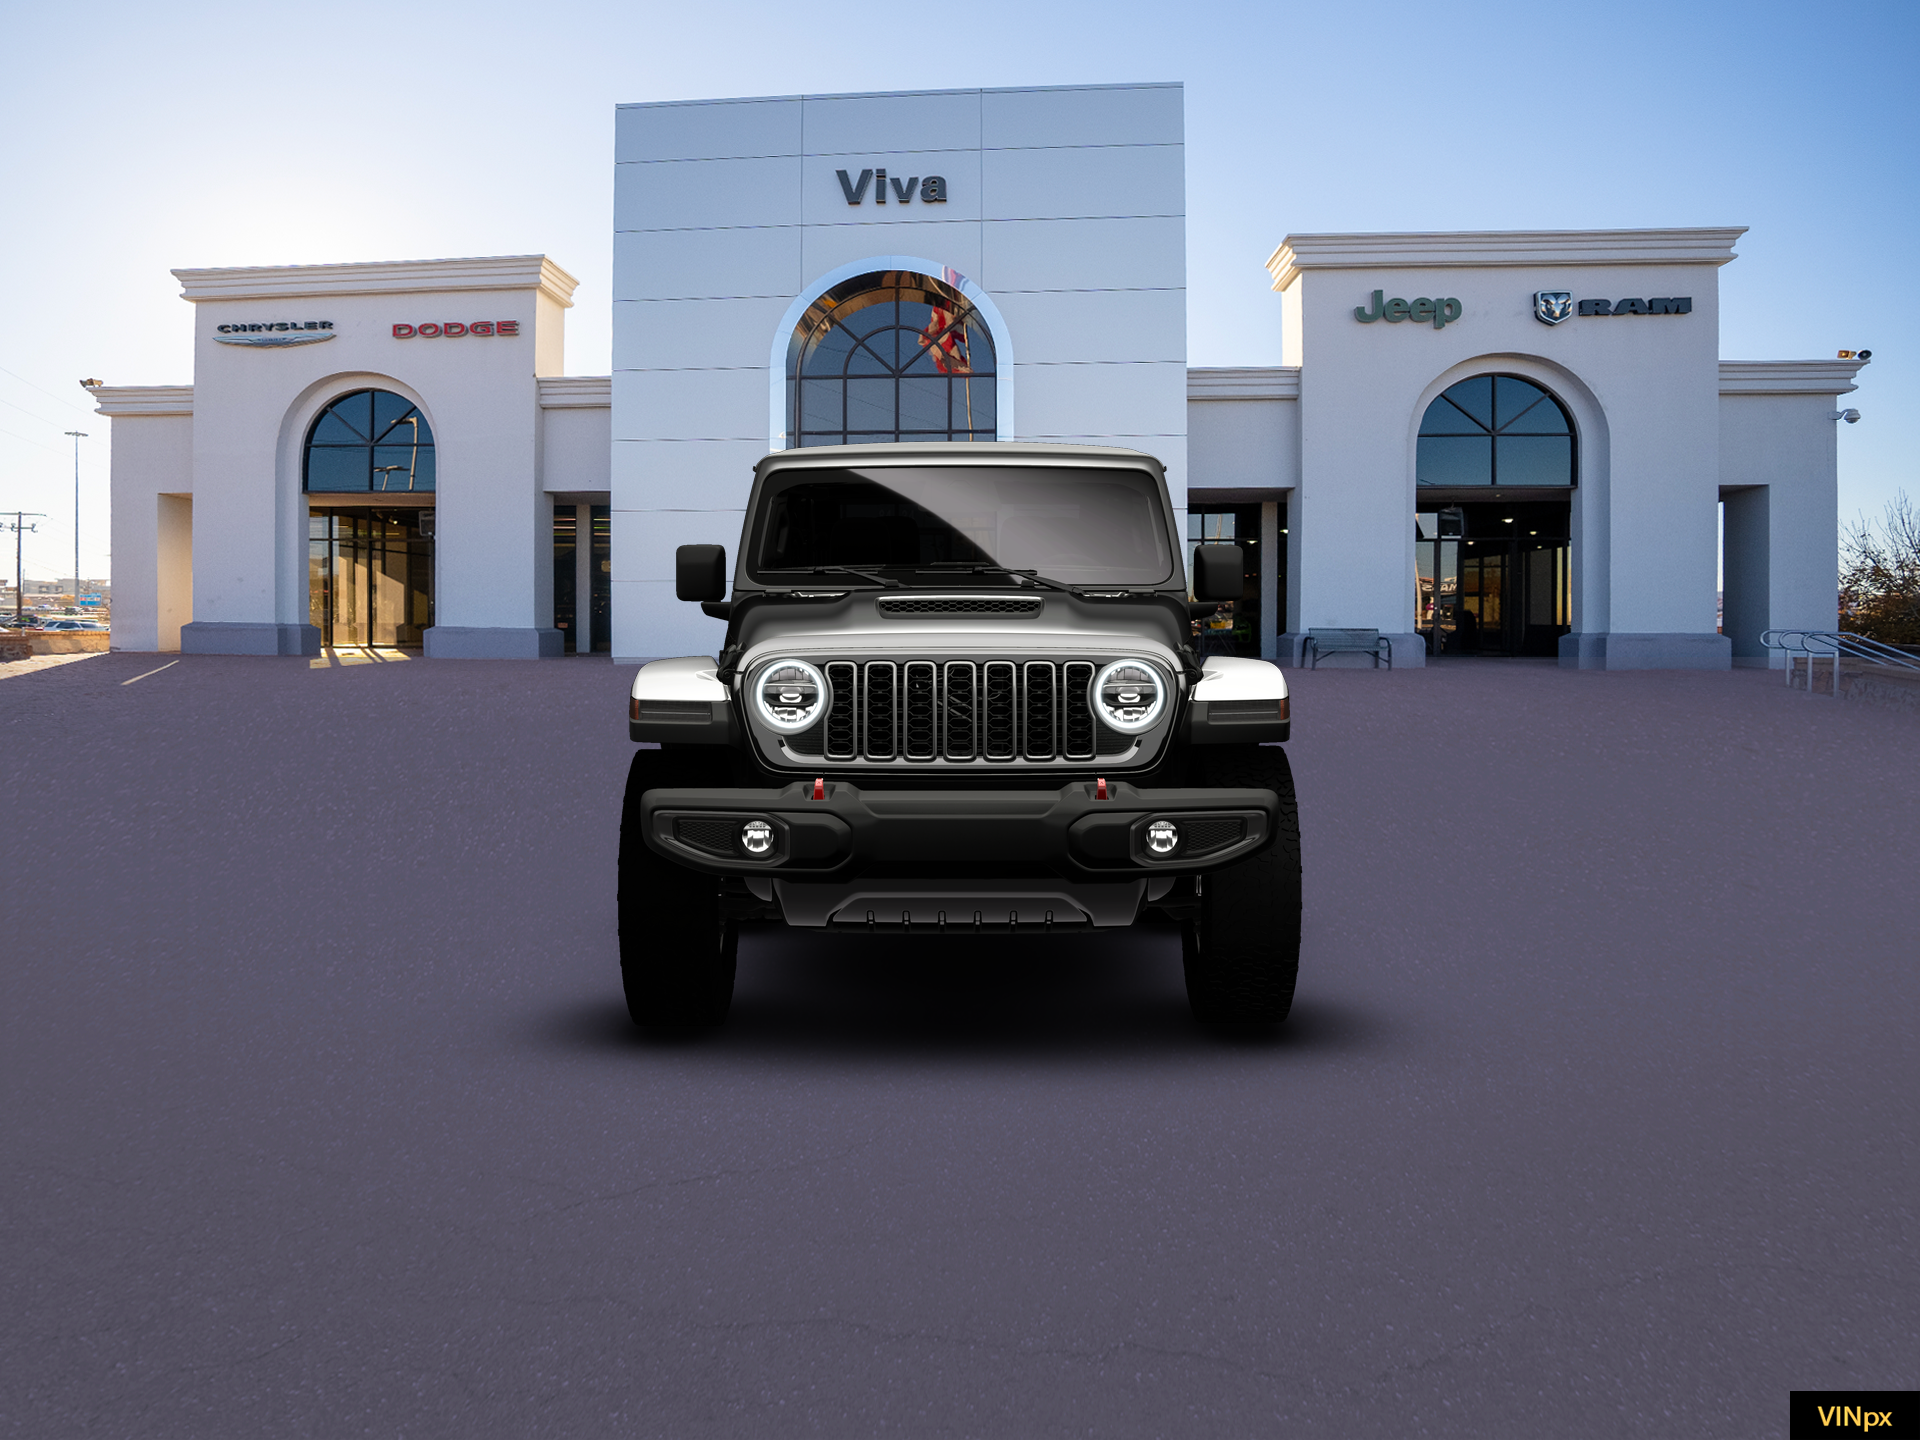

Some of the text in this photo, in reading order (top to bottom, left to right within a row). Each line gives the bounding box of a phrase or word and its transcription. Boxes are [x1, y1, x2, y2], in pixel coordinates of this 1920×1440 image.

[835, 168, 947, 205] Viva
[1354, 289, 1463, 329] Jeep
[1578, 297, 1692, 317] RAM
[217, 320, 334, 334] CHRYSLER
[392, 320, 519, 339] DODGE
